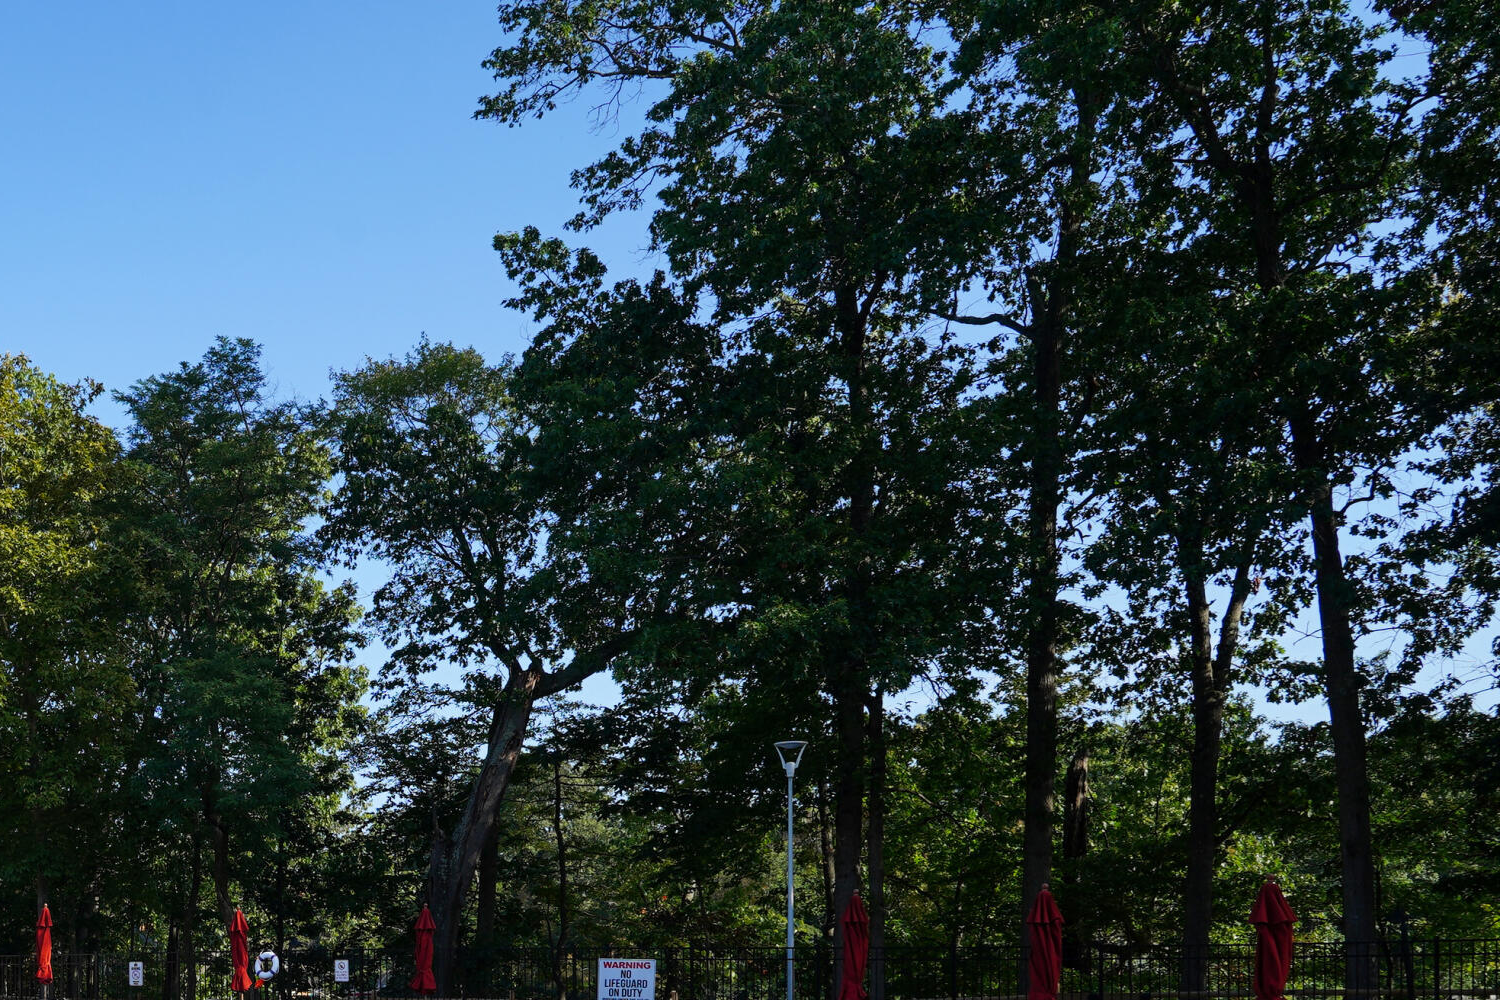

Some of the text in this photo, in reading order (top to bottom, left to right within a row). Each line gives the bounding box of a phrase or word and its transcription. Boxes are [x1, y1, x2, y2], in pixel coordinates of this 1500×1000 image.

[603, 961, 651, 969] WARNING
[620, 969, 632, 979] NO
[604, 979, 648, 989] LIFEGUARD
[608, 988, 643, 998] ON DUTY
